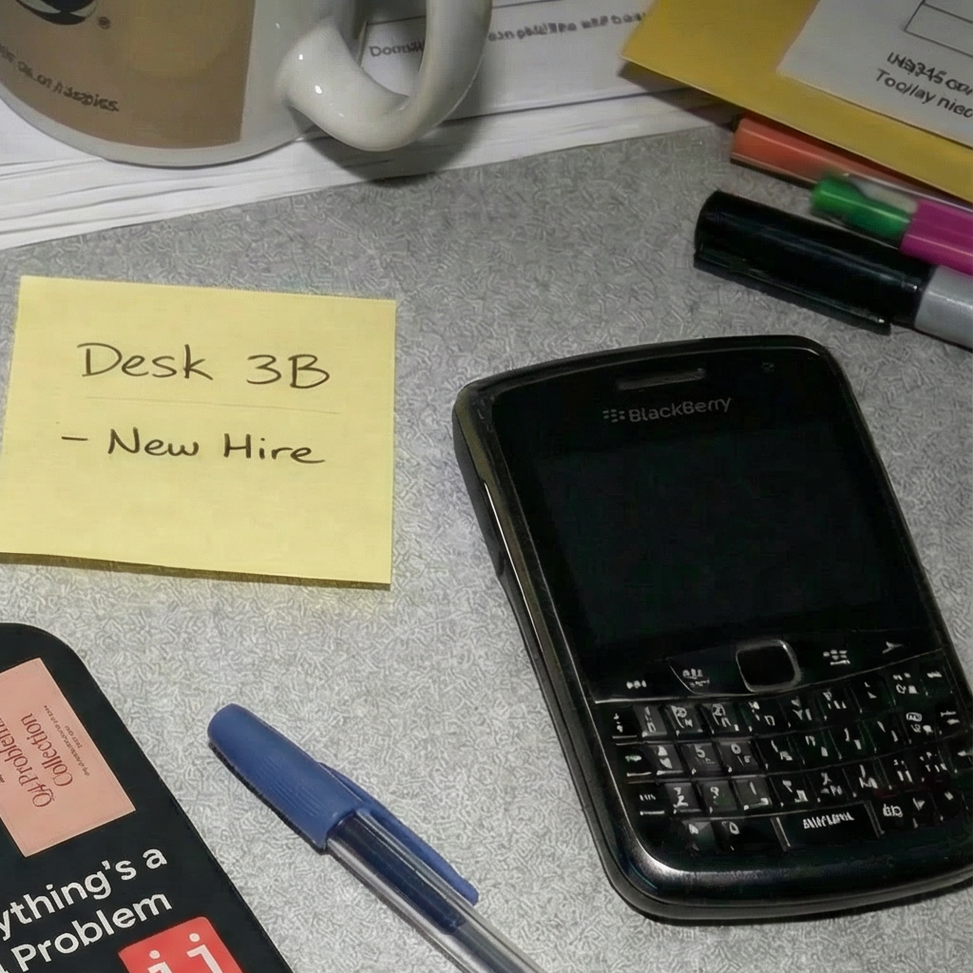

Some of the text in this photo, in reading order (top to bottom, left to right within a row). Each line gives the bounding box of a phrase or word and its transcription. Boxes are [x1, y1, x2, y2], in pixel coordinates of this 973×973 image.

[77, 342, 330, 389] Desk 3B
[629, 397, 732, 422] BlackBerry
[107, 426, 199, 456] New
[222, 432, 326, 464] Hire
[20, 712, 73, 788] Collection
[142, 847, 167, 870] a
[13, 890, 173, 973] Problem
